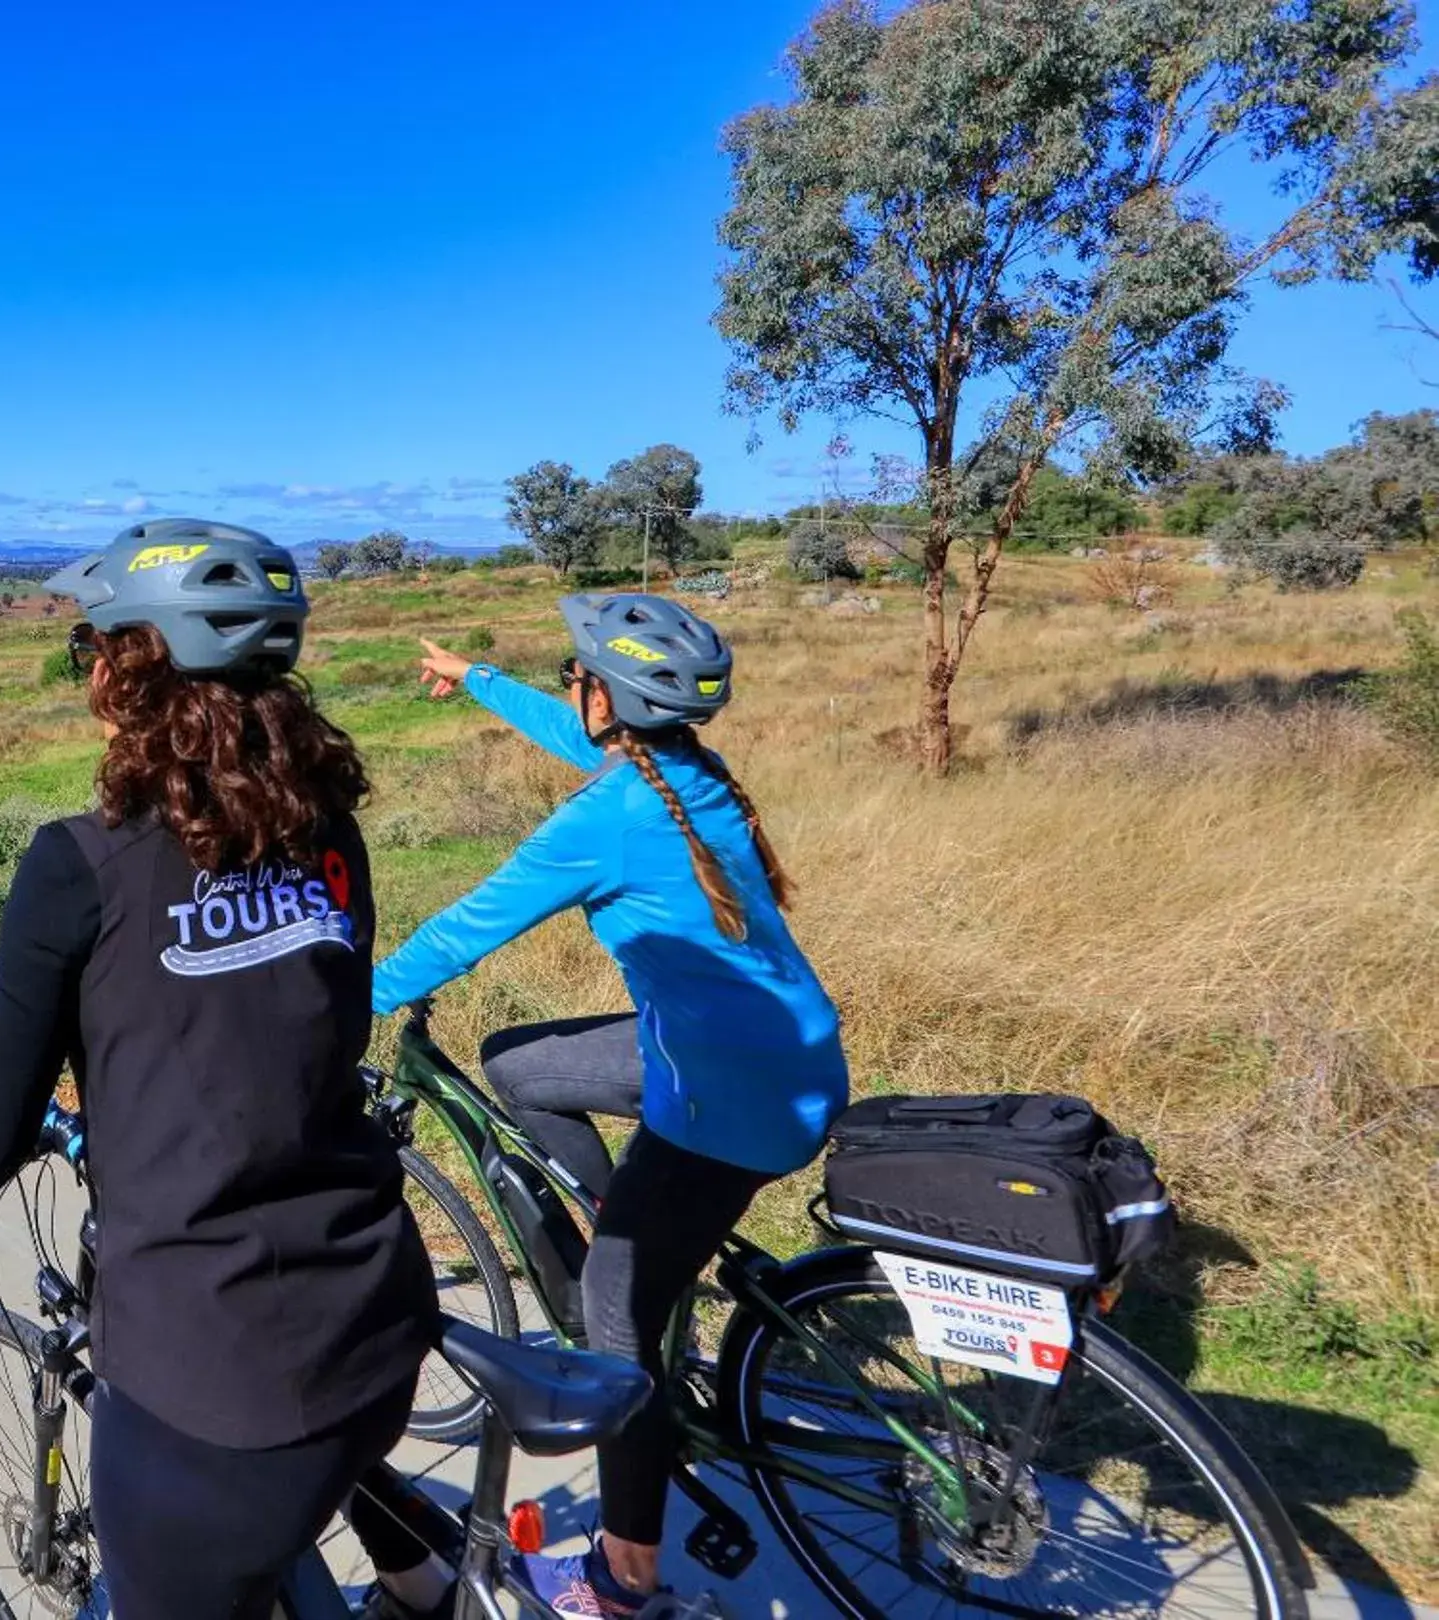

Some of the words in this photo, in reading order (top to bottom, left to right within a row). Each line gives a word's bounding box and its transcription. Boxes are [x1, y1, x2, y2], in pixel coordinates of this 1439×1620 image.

[168, 880, 329, 945] TOURS
[846, 1195, 1051, 1254] TOPEAK
[905, 1266, 981, 1298] E-BIKE
[986, 1282, 1044, 1310] HIRE
[944, 1327, 1007, 1353] TOURS
[1040, 1349, 1054, 1362] 3
